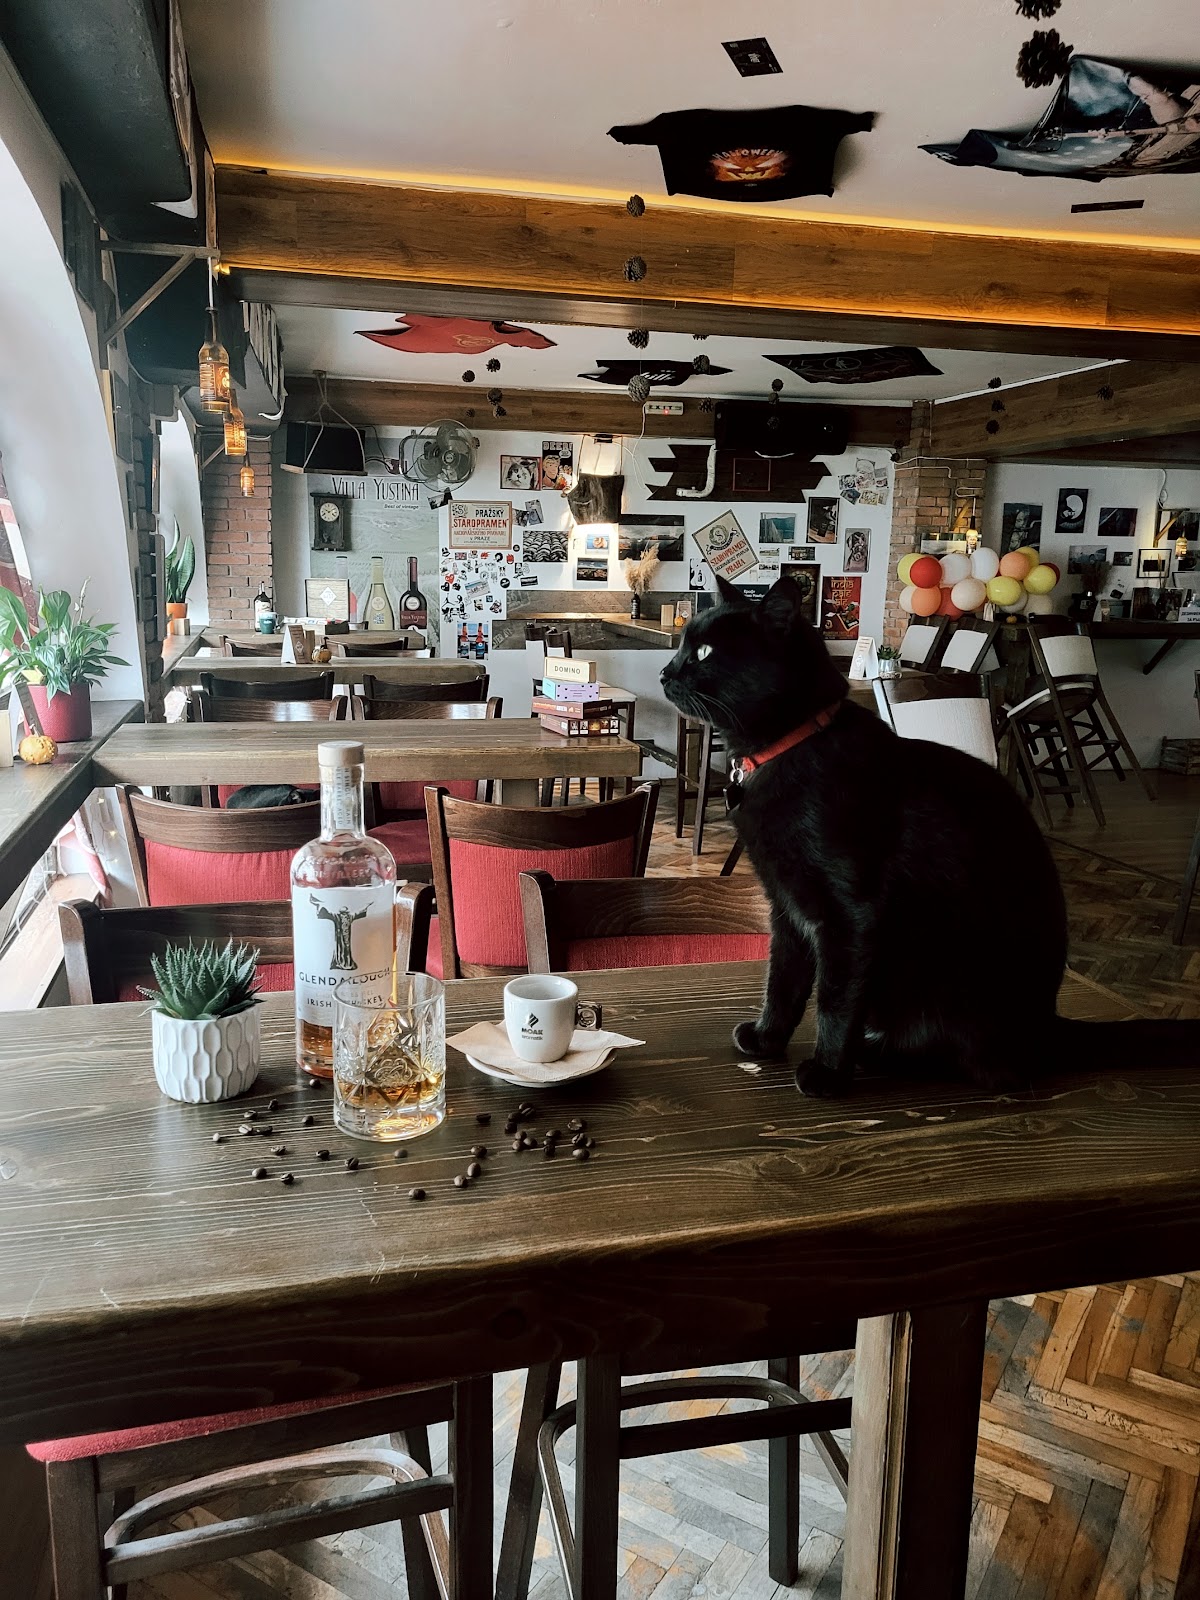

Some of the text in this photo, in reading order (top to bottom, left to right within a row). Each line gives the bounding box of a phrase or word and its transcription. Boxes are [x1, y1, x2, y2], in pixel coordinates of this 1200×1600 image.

[712, 148, 783, 159] HALLOWEEN
[332, 477, 419, 501] VILLA YUSTINA
[453, 518, 508, 528] STAROPRAMEN
[710, 539, 747, 567] STAROPRAMEN
[725, 558, 746, 575] PRAHA
[554, 665, 581, 675] DOMINO
[307, 998, 332, 1007] IRISH
